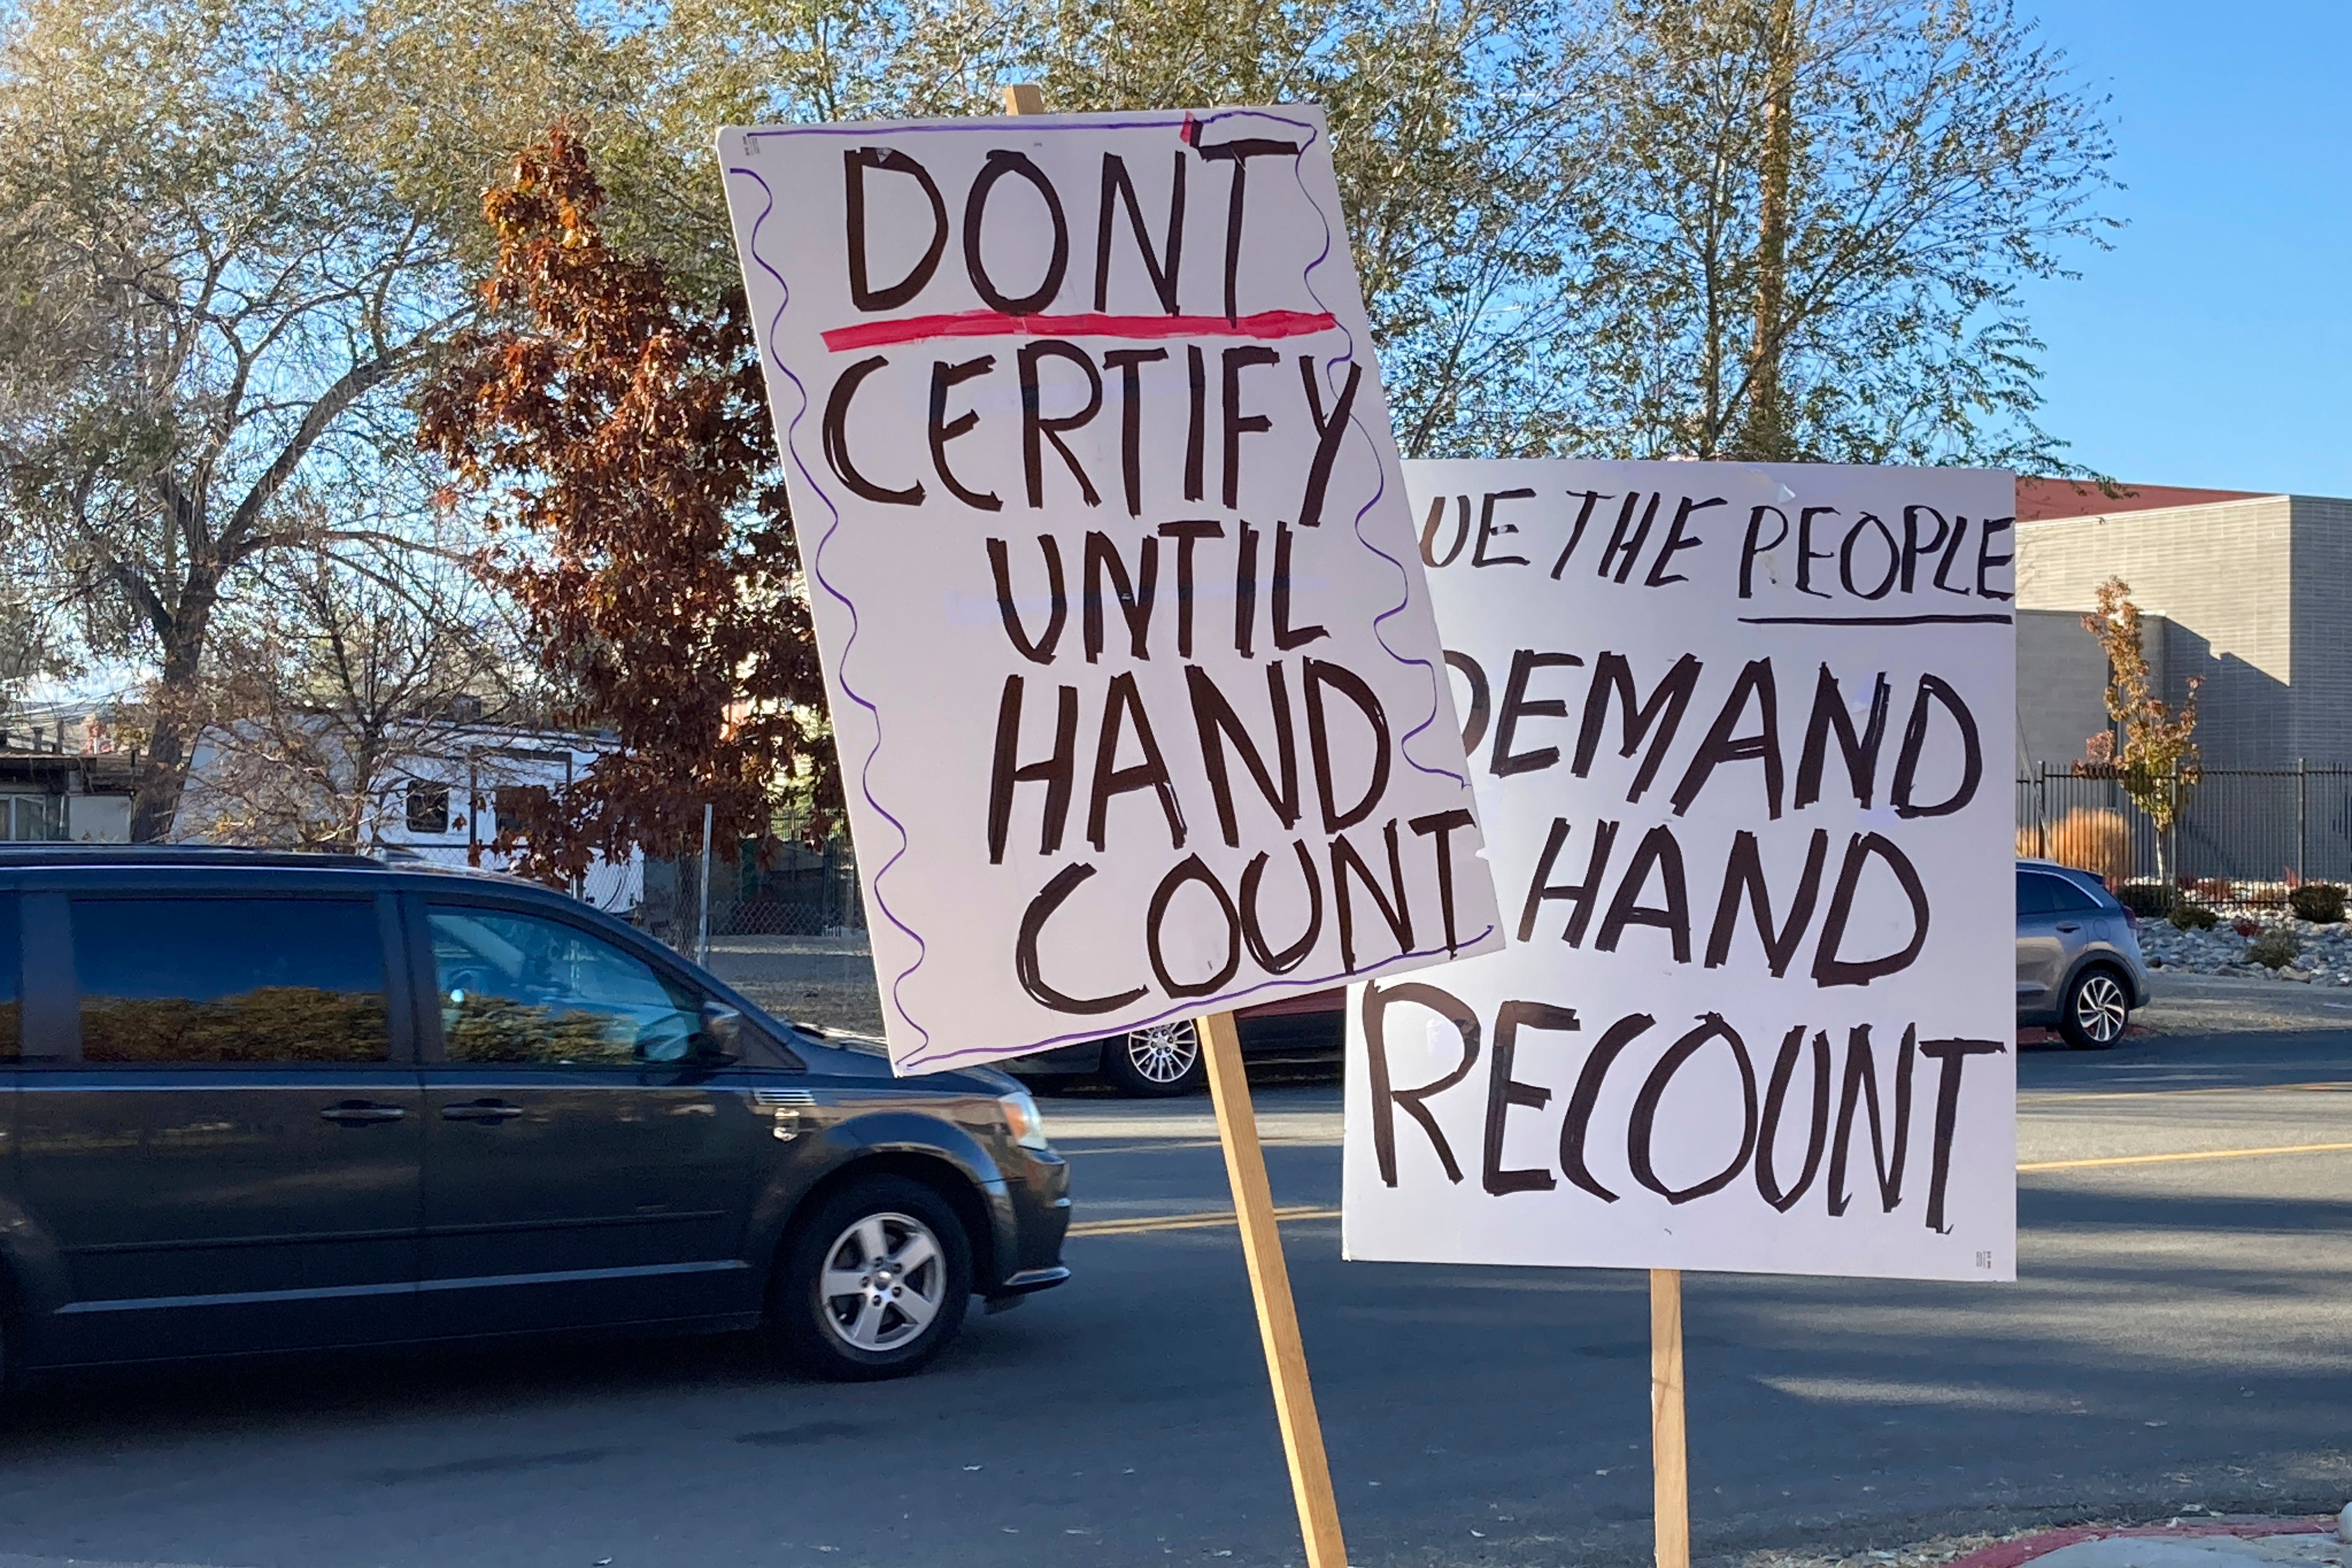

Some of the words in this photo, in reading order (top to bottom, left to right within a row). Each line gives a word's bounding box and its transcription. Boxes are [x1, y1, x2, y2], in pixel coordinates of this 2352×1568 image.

[823, 339, 1362, 526] CERTIFY
[987, 520, 1330, 665] UNTIL
[1551, 489, 1727, 587] THE
[1737, 504, 2015, 600] PEOPLE
[987, 656, 1391, 866] HAND
[1016, 808, 1477, 1015] COUNT
[1517, 817, 1930, 988] HAND
[1362, 980, 2008, 1234] RECOUNT
